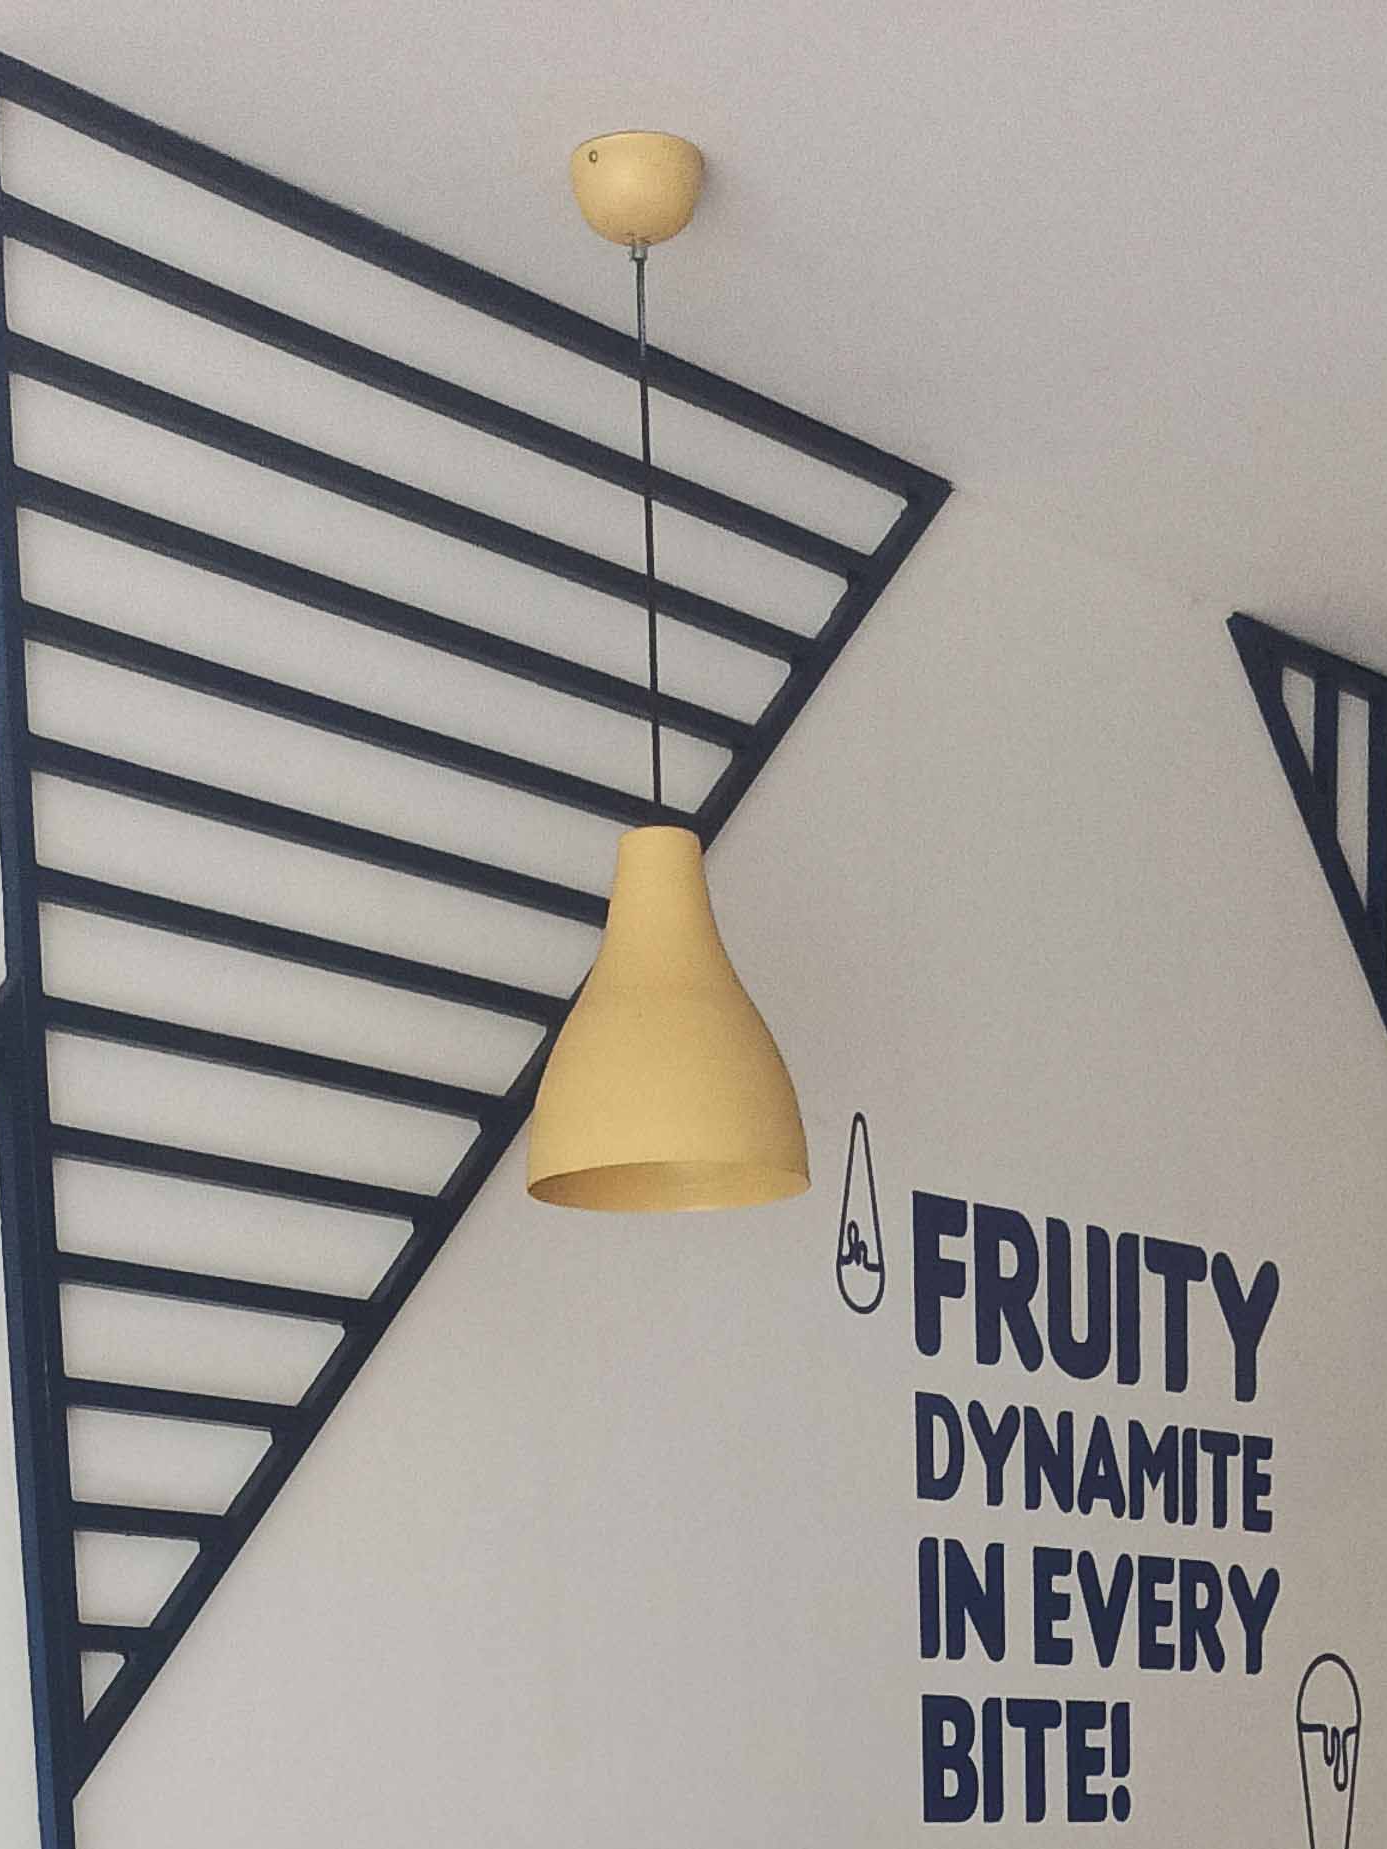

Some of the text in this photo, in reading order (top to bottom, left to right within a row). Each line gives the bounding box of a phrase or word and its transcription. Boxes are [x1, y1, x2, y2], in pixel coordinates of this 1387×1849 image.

[911, 1190, 1280, 1402] FRUITY
[914, 1391, 1274, 1533] DYNAMITE
[918, 1537, 1280, 1674] IN EVERY
[921, 1694, 1131, 1824] BITE!
